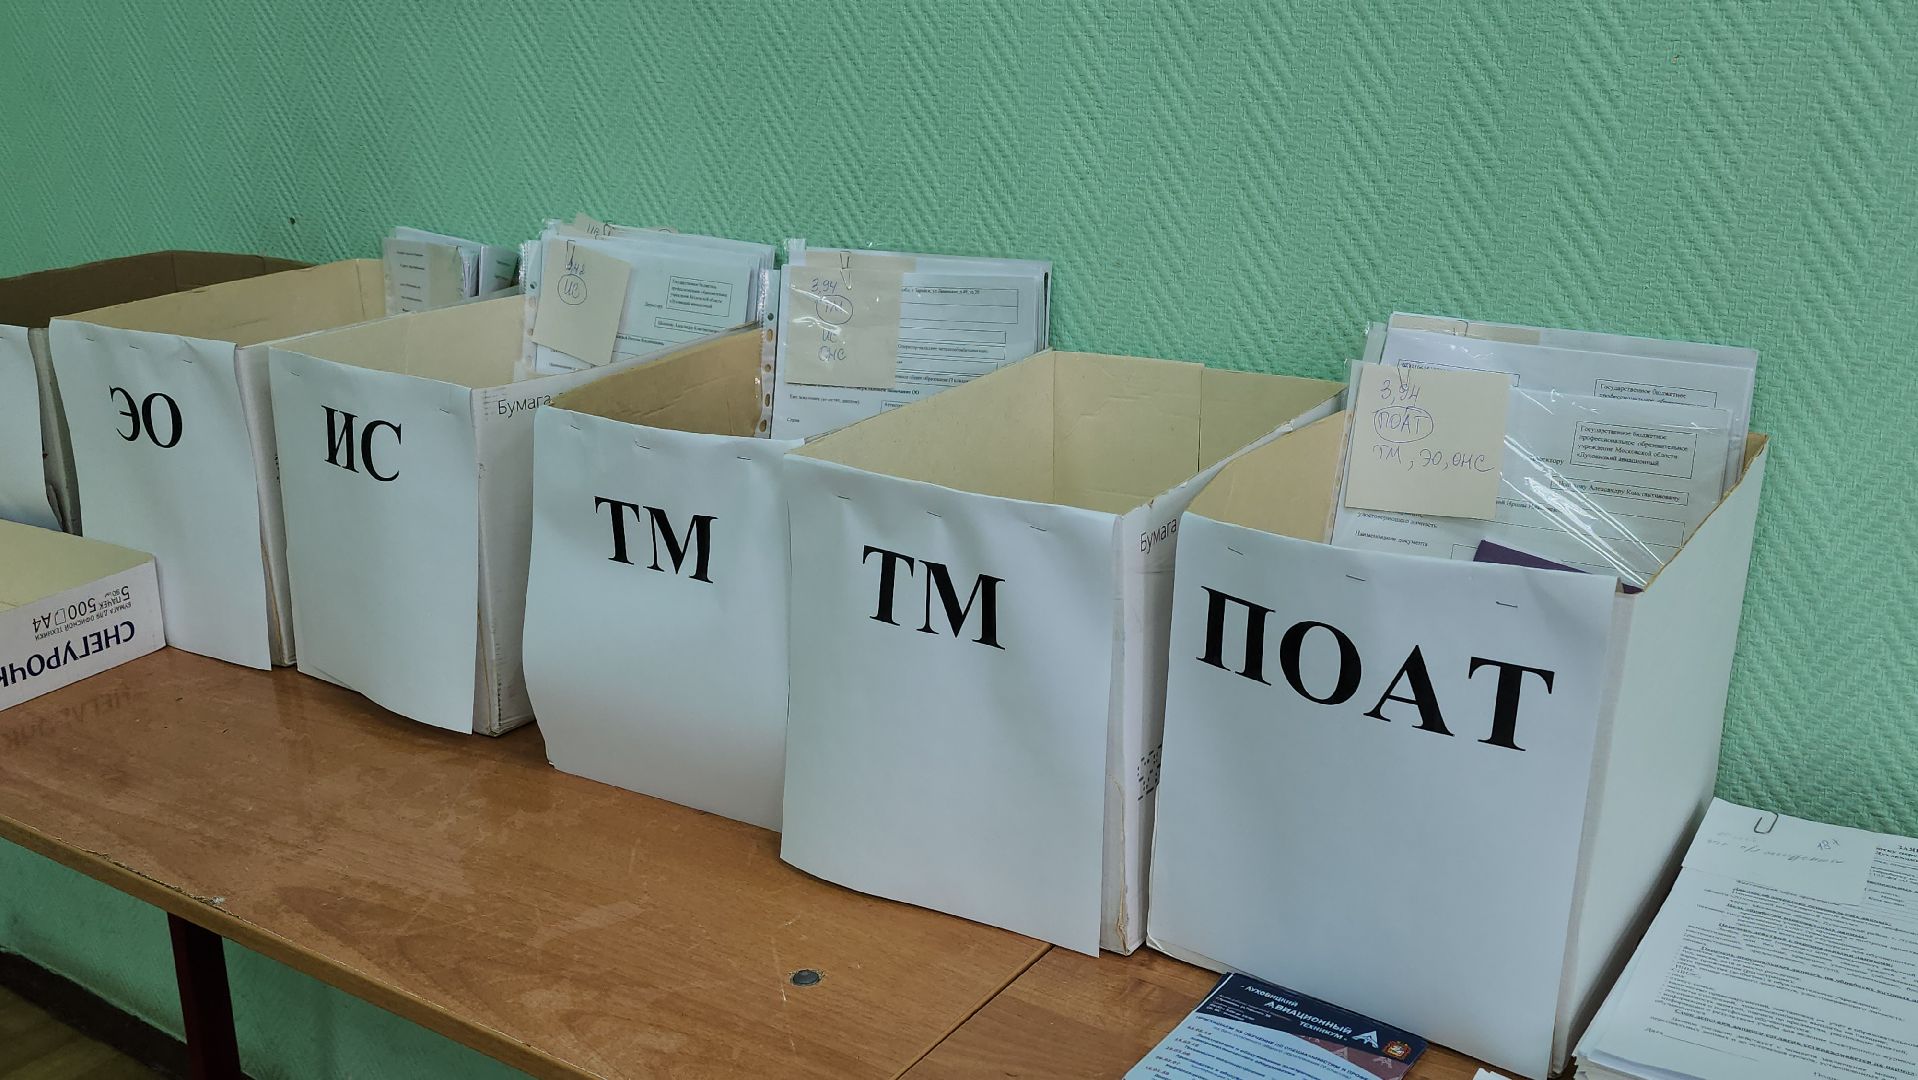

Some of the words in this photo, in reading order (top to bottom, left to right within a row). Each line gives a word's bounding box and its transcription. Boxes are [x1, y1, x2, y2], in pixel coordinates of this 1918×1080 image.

[109, 386, 182, 448] ЭО
[497, 394, 552, 419] Бумага
[321, 405, 402, 481] ИС
[595, 496, 718, 583] ТМ
[1139, 518, 1178, 555] Бумага
[67, 597, 97, 620] 500
[99, 597, 122, 611] ПАЧЕК
[121, 585, 131, 602] 5
[863, 545, 1005, 650] ТМ
[1196, 585, 1556, 752] ПОАТ
[1263, 1000, 1354, 1035] АВИАЦИОННЫЙ
[1299, 1020, 1344, 1040] ТЕХНИКУМ
